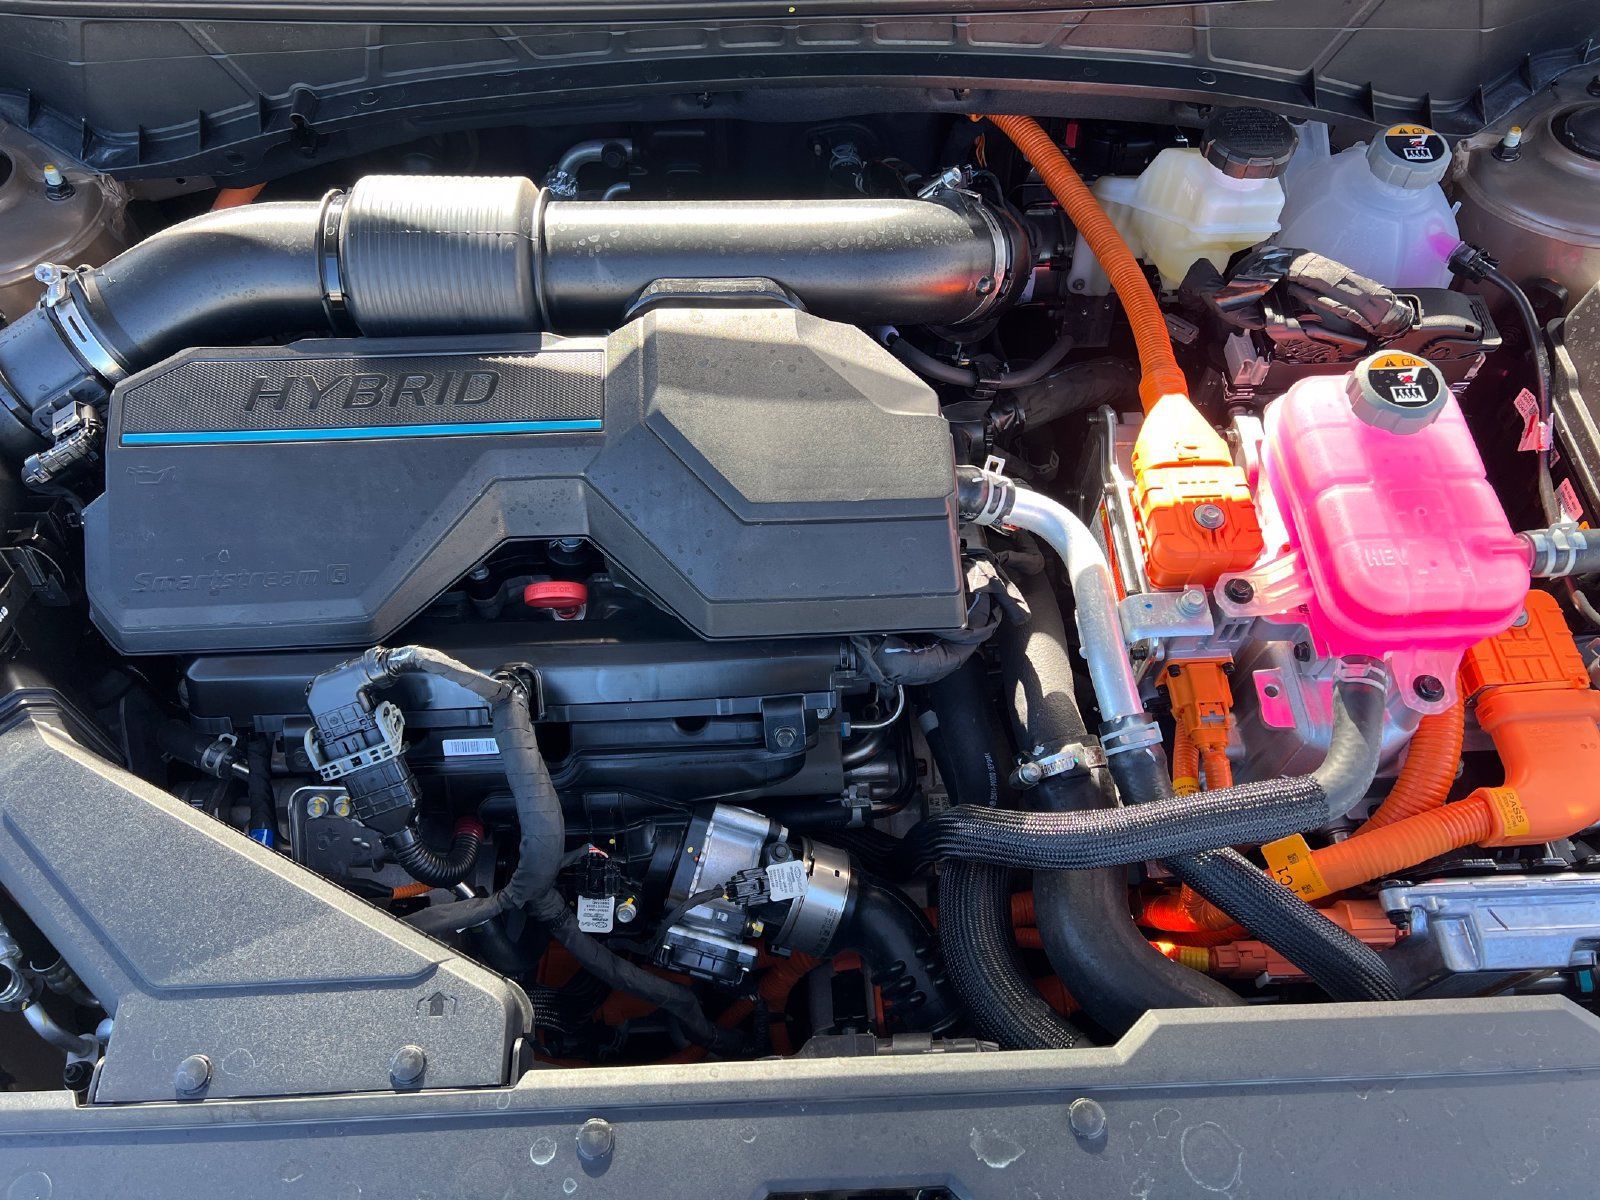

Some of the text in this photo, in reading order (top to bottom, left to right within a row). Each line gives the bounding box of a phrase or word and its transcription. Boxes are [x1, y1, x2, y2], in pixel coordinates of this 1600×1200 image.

[244, 370, 502, 412] HYBRID
[1364, 546, 1409, 567] HEV
[131, 569, 320, 593] Smartstream
[1506, 792, 1525, 823] PASS
